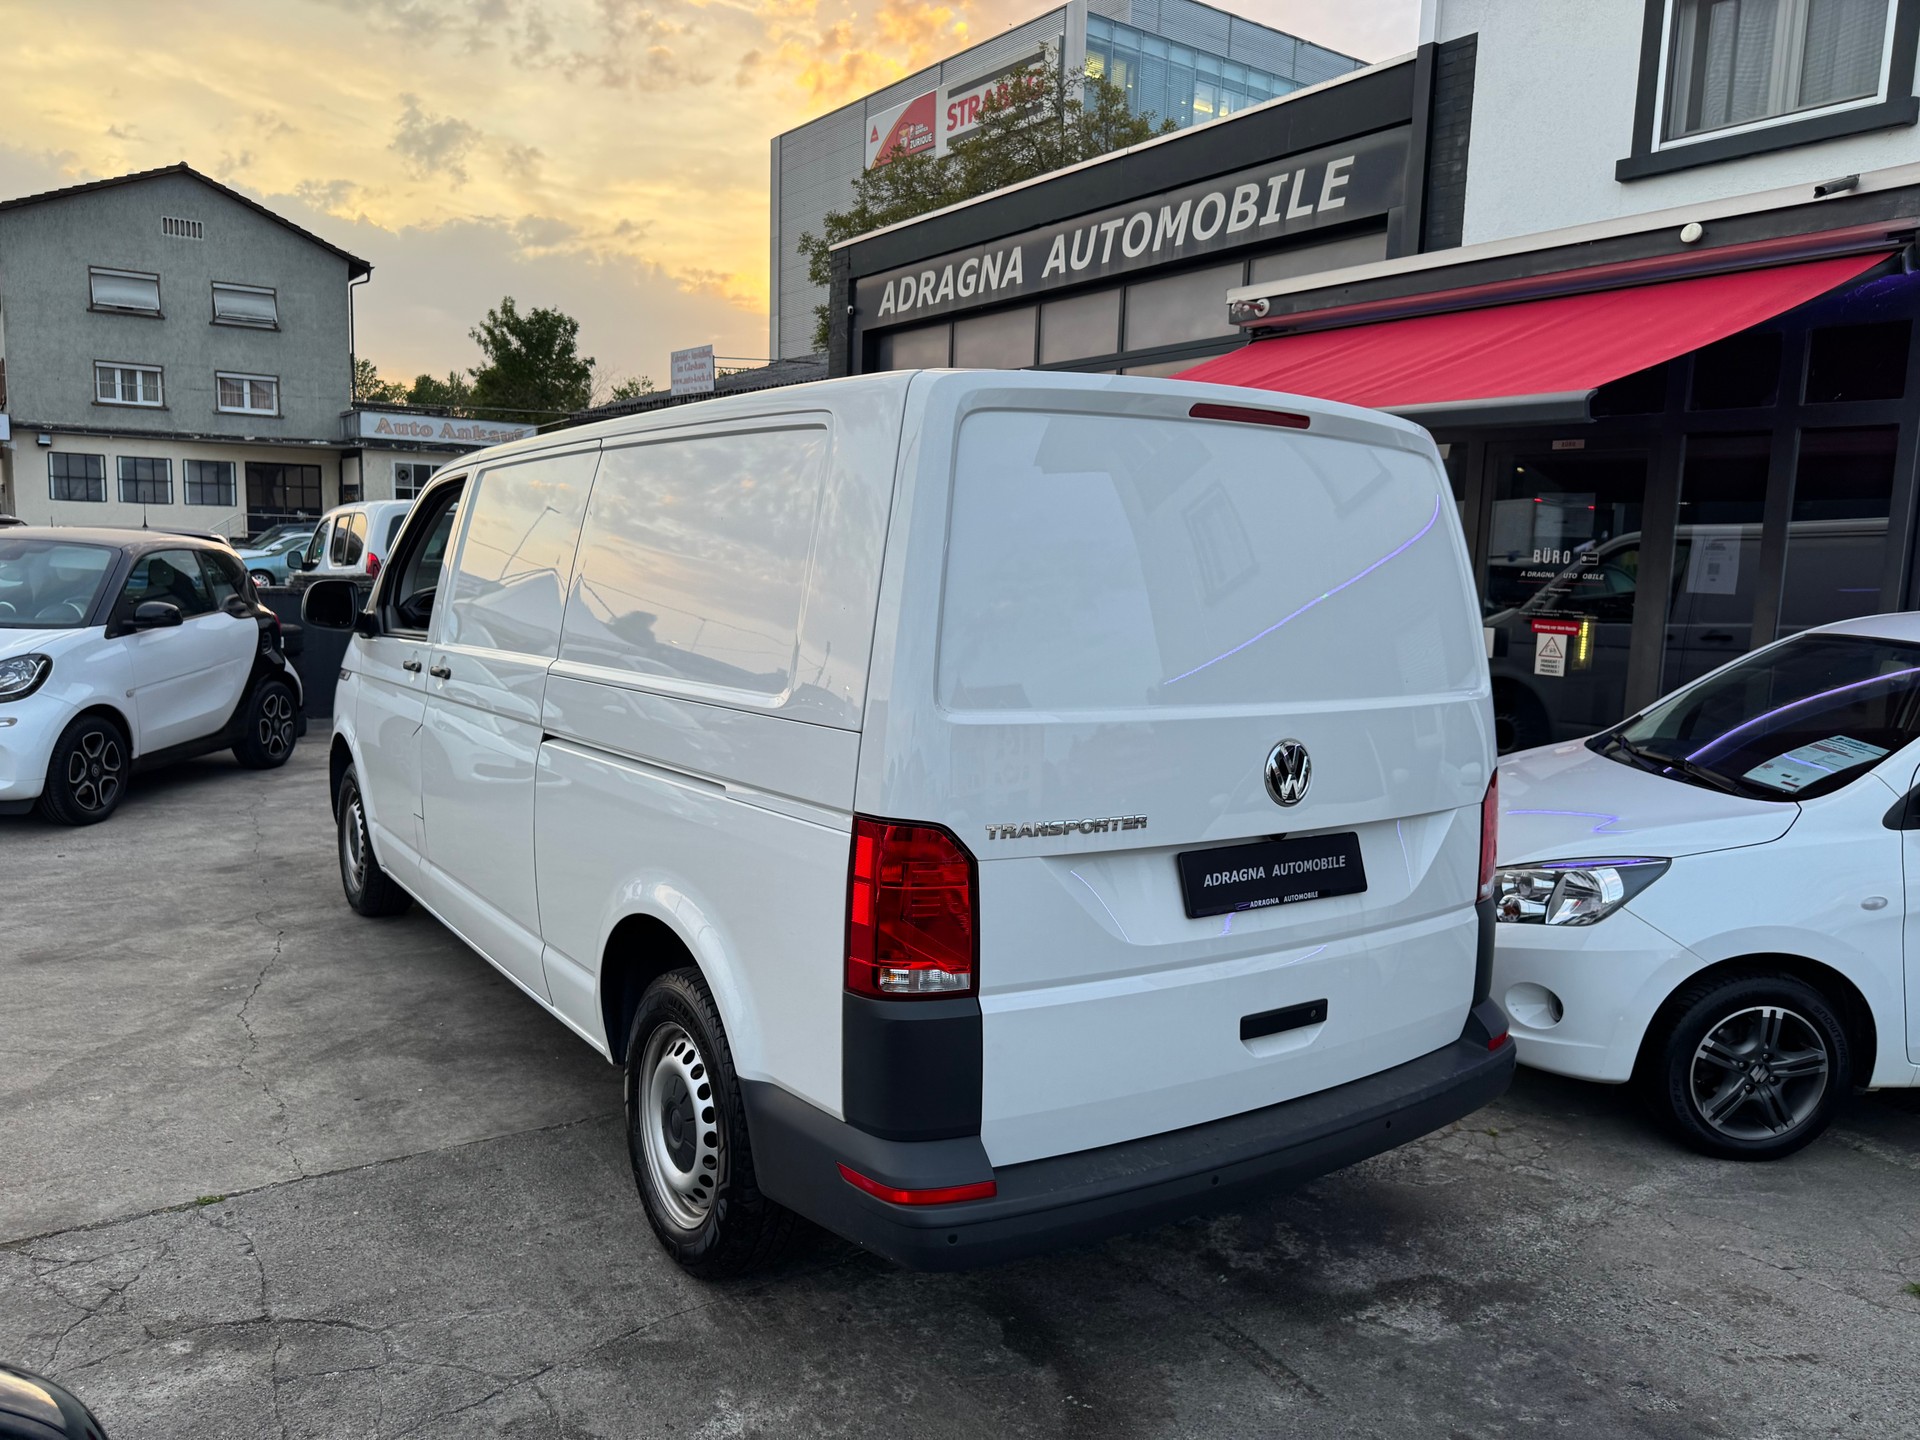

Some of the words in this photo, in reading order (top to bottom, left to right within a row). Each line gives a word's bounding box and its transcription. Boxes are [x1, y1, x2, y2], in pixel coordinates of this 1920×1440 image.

[910, 133, 933, 150] ZURIQUE
[878, 246, 1023, 317] ADRAGNA
[1041, 155, 1355, 278] AUTOMOBILE
[375, 417, 434, 437] Auto
[1533, 547, 1571, 564] BÜRO
[985, 813, 1148, 840] TRANSPORTER
[1203, 866, 1266, 888] ADRAGNA
[1272, 855, 1346, 877] AUTOMOBILE
[1250, 897, 1280, 908] ADRAGNA
[1283, 890, 1319, 903] AUTOMOBILE
